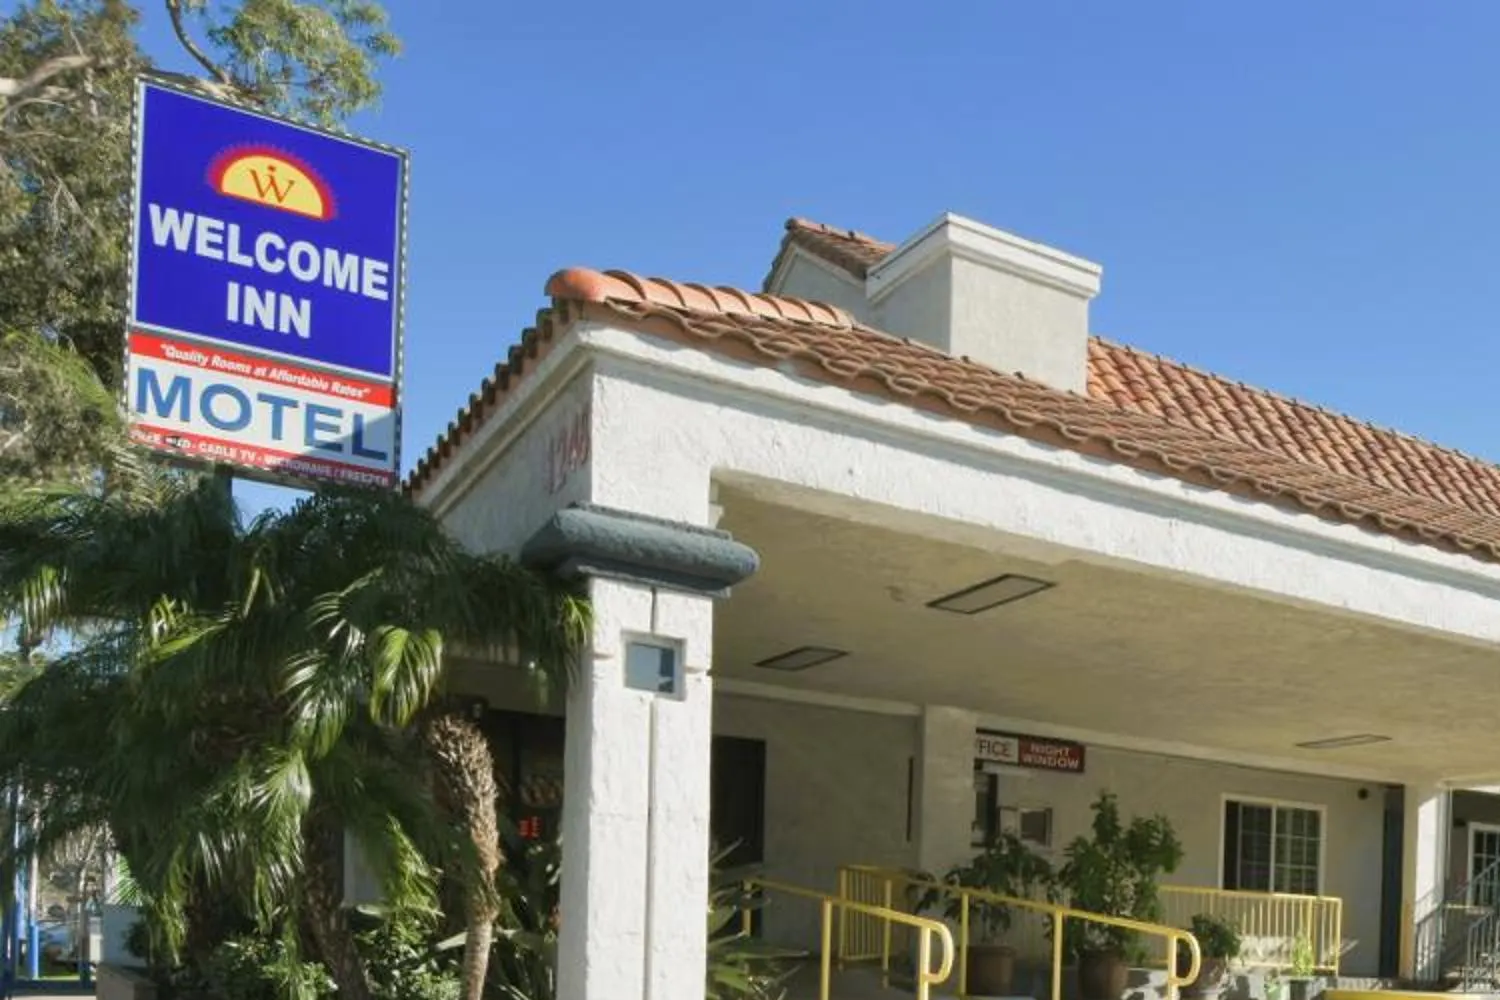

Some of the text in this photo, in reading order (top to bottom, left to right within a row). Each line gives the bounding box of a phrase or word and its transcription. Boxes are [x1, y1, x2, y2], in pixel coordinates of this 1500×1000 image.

[148, 203, 389, 301] WELCOME
[227, 281, 311, 339] INN
[211, 354, 252, 374] Rooms
[254, 366, 267, 378] at
[268, 367, 329, 391] Affordable
[136, 367, 387, 462] MOTEL
[199, 441, 237, 458] CABLE
[240, 449, 257, 462] TV
[1022, 753, 1080, 770] WINDOW
[1030, 742, 1070, 758] NIGHT
